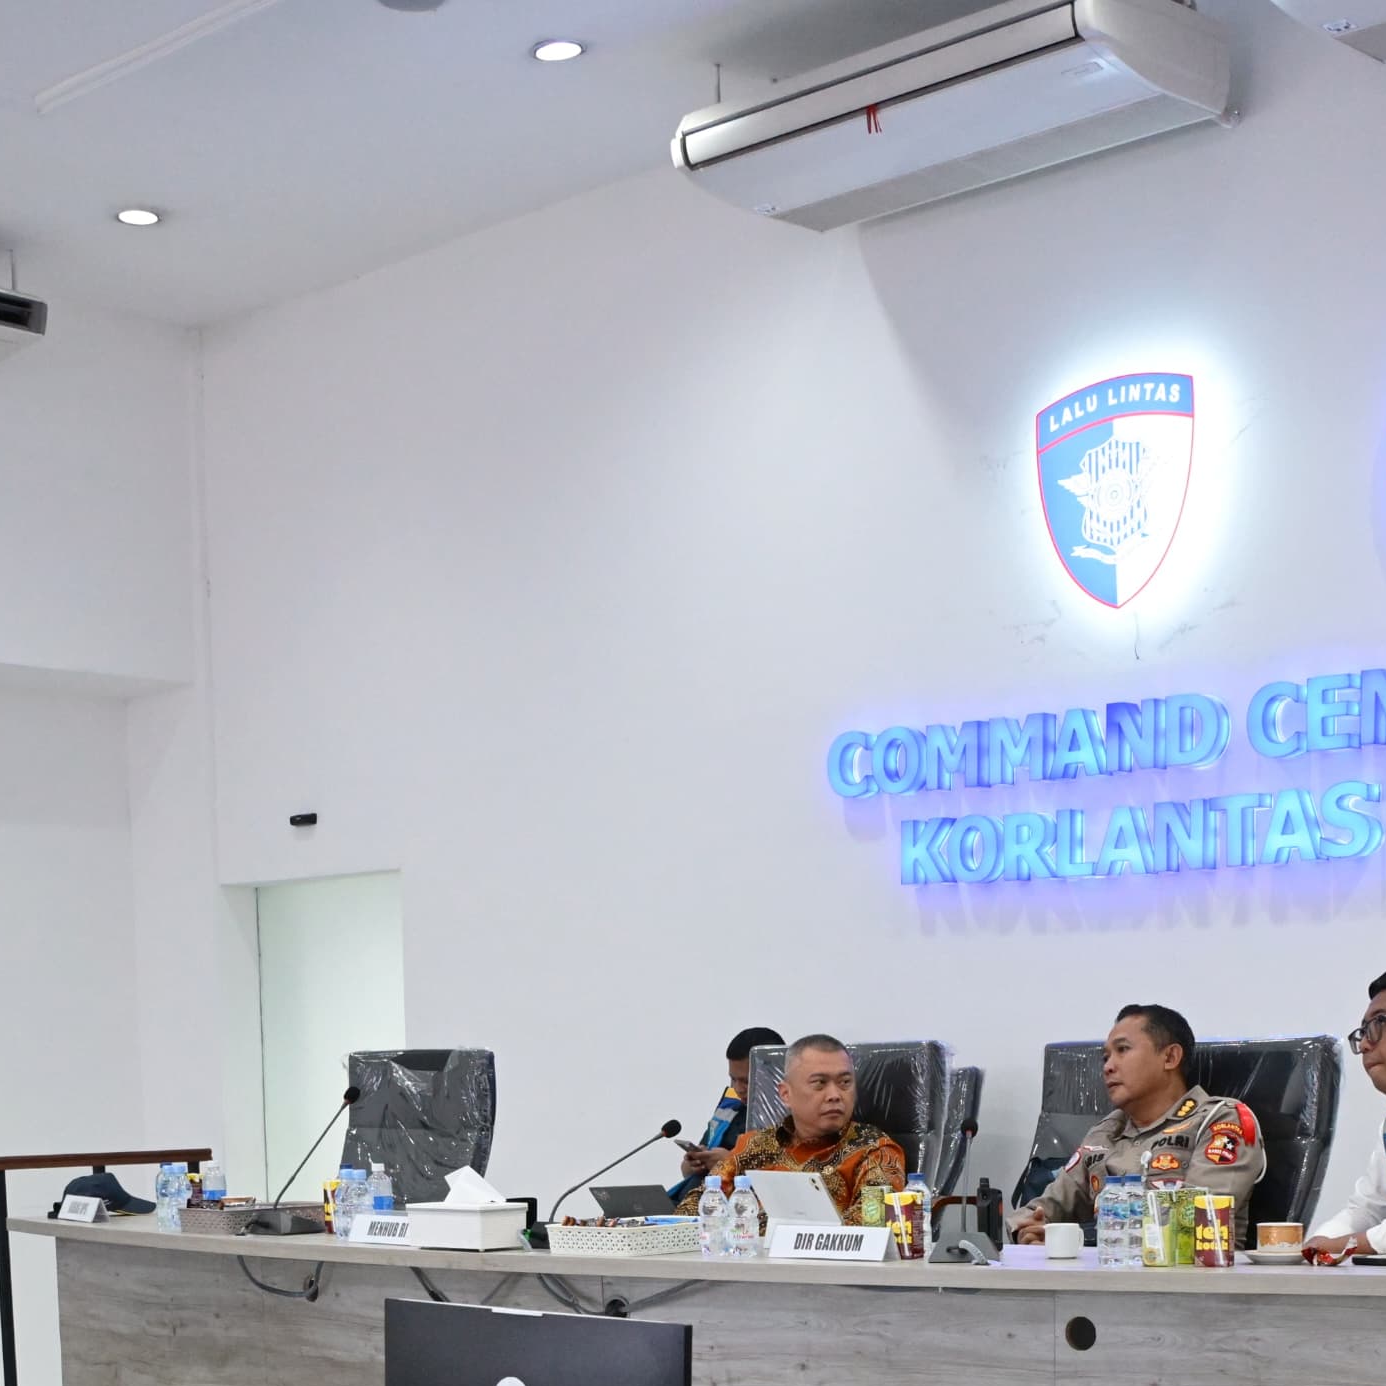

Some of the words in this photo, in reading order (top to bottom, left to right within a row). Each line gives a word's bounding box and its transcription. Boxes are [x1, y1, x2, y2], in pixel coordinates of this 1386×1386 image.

[1049, 393, 1098, 432] LALU
[1108, 383, 1181, 405] LINTAS
[827, 692, 1231, 800] COMMAND
[900, 780, 1384, 886] KORLANTAS
[1151, 1135, 1190, 1150] POLRI
[367, 1220, 399, 1238] MENHUB
[793, 1232, 814, 1251] DIR
[815, 1232, 865, 1252] GAKKUM
